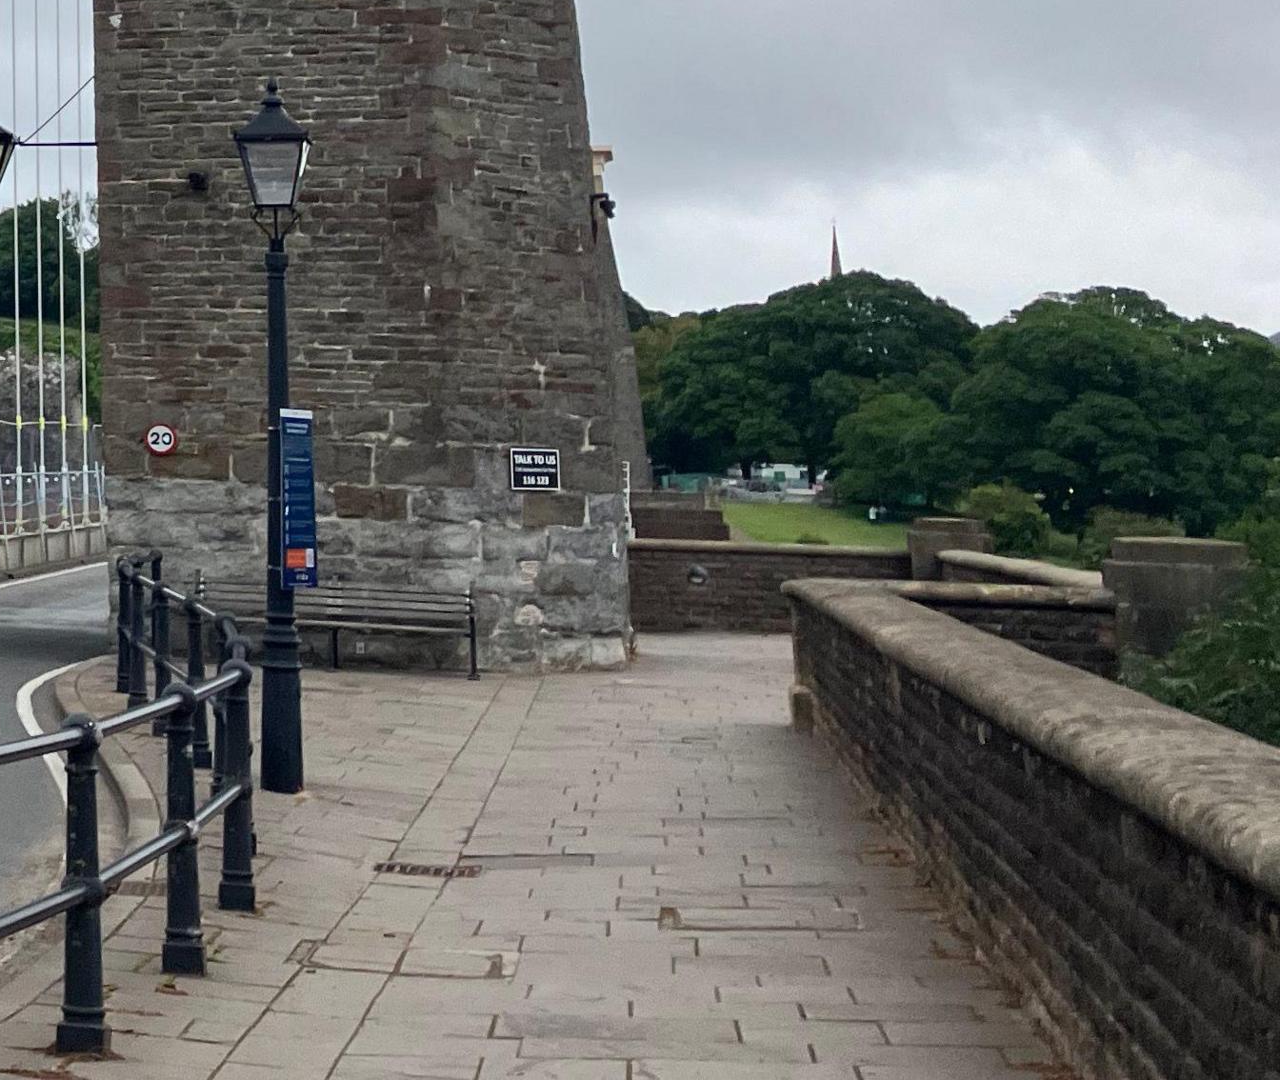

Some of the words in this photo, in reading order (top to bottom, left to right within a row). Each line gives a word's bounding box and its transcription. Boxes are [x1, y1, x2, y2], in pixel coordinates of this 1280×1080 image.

[150, 432, 172, 445] 20
[514, 455, 533, 465] TALK
[533, 455, 545, 465] TO
[545, 455, 556, 465] US
[537, 476, 549, 485] 123
